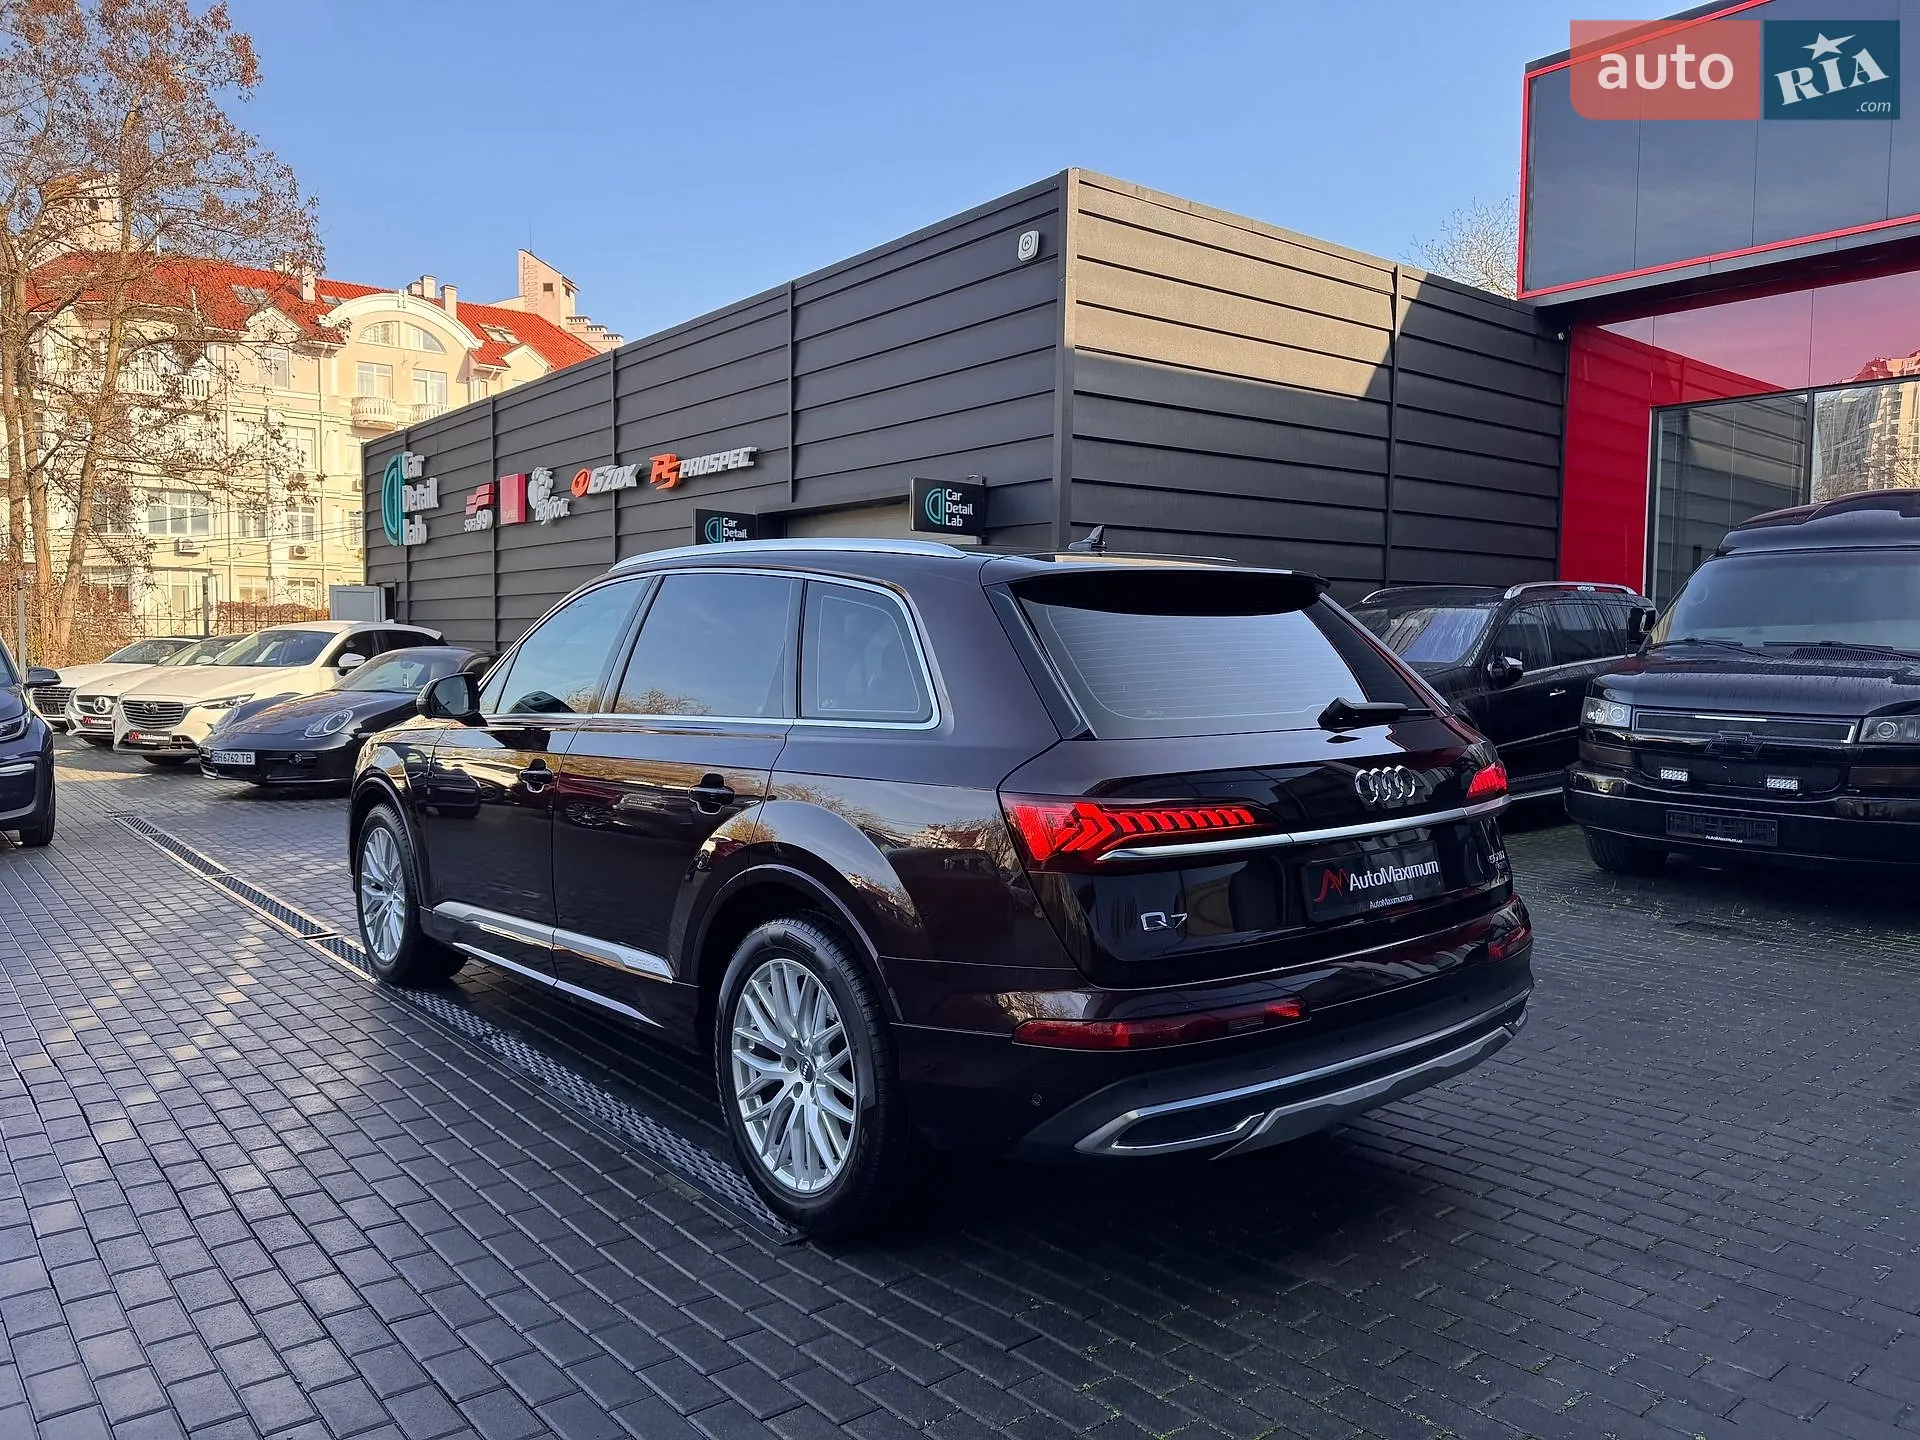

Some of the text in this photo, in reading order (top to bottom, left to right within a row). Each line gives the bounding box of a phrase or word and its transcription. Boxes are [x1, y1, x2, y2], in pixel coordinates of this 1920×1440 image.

[402, 451, 424, 479] Car
[679, 446, 757, 478] PROSPEC
[402, 478, 439, 513] Detail
[946, 489, 962, 501] Car
[946, 501, 973, 515] Detail
[723, 517, 738, 527] Car
[946, 514, 962, 526] Lab
[402, 515, 427, 546] Lab
[723, 527, 748, 538] Detail
[223, 752, 239, 763] 6762
[240, 753, 252, 763] TB
[1349, 860, 1440, 892] AutoMaximum
[1141, 911, 1188, 931] Q7
